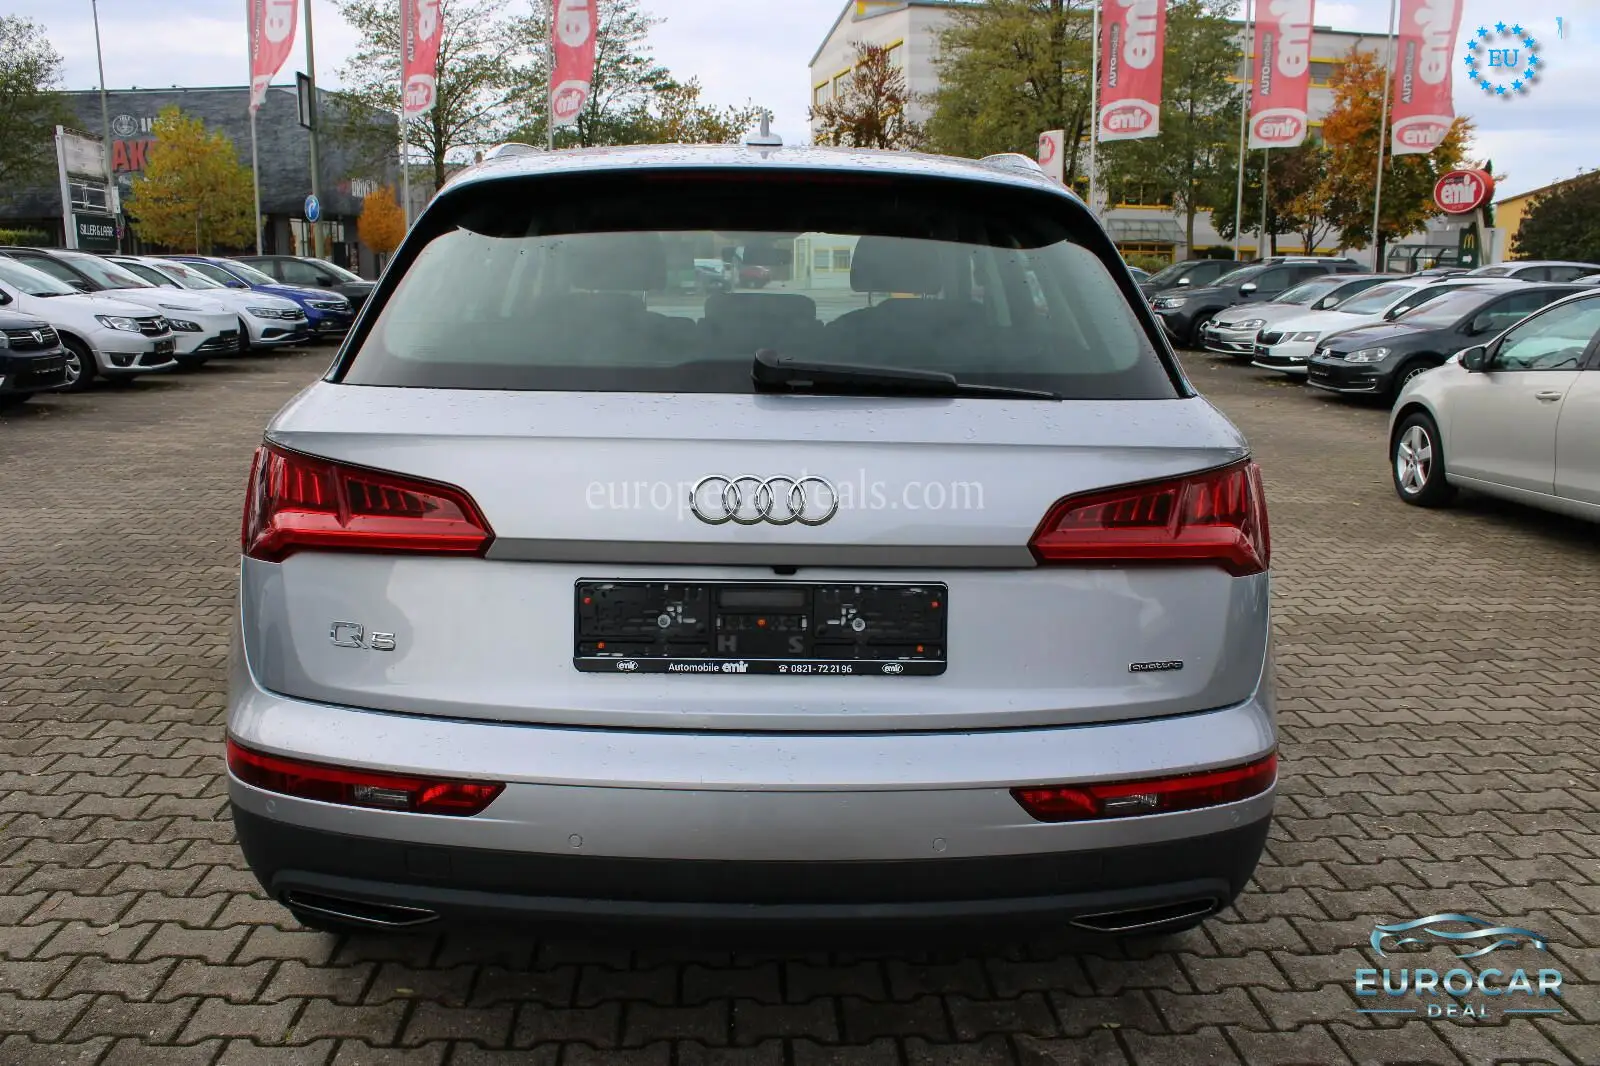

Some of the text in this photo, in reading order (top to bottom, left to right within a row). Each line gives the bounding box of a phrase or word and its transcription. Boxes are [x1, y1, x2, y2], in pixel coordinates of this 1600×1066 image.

[1108, 109, 1147, 129] emir
[1260, 117, 1297, 137] emir
[1441, 174, 1477, 204] emir
[330, 620, 396, 651] Q5
[668, 660, 748, 673] Automobile emir
[1132, 661, 1182, 672] quattro
